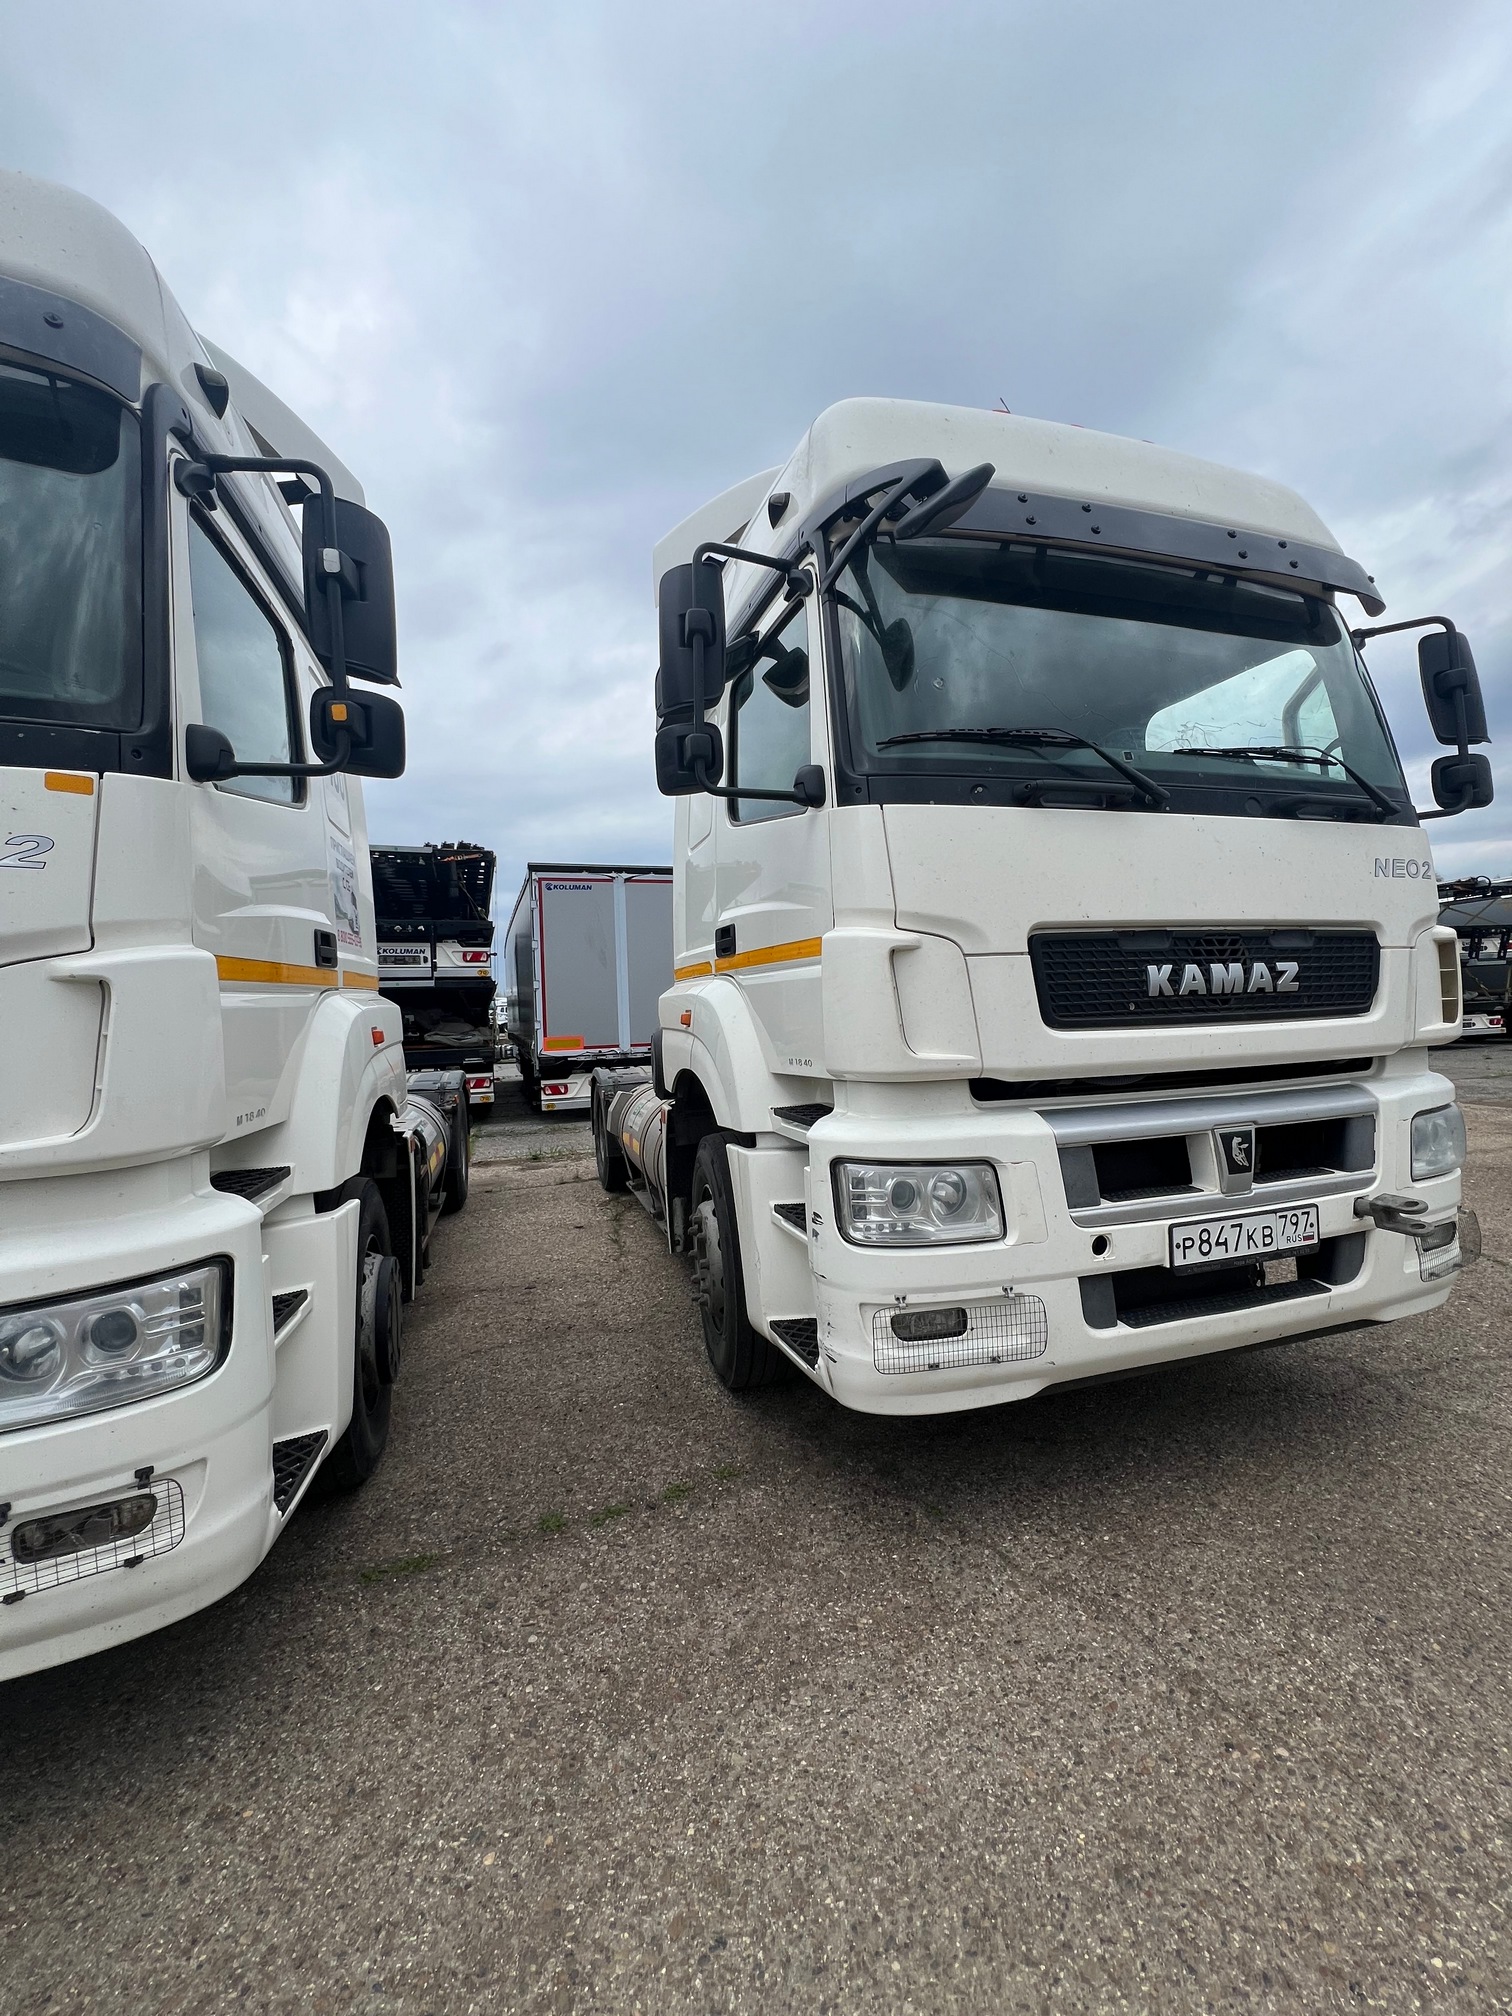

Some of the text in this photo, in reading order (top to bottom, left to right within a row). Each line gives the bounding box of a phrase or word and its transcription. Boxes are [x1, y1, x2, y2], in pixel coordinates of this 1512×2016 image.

[1374, 858, 1432, 880] NEO2
[1147, 961, 1300, 997] KAMAZ
[1278, 1211, 1311, 1237] 797
[1286, 1233, 1303, 1244] RUS
